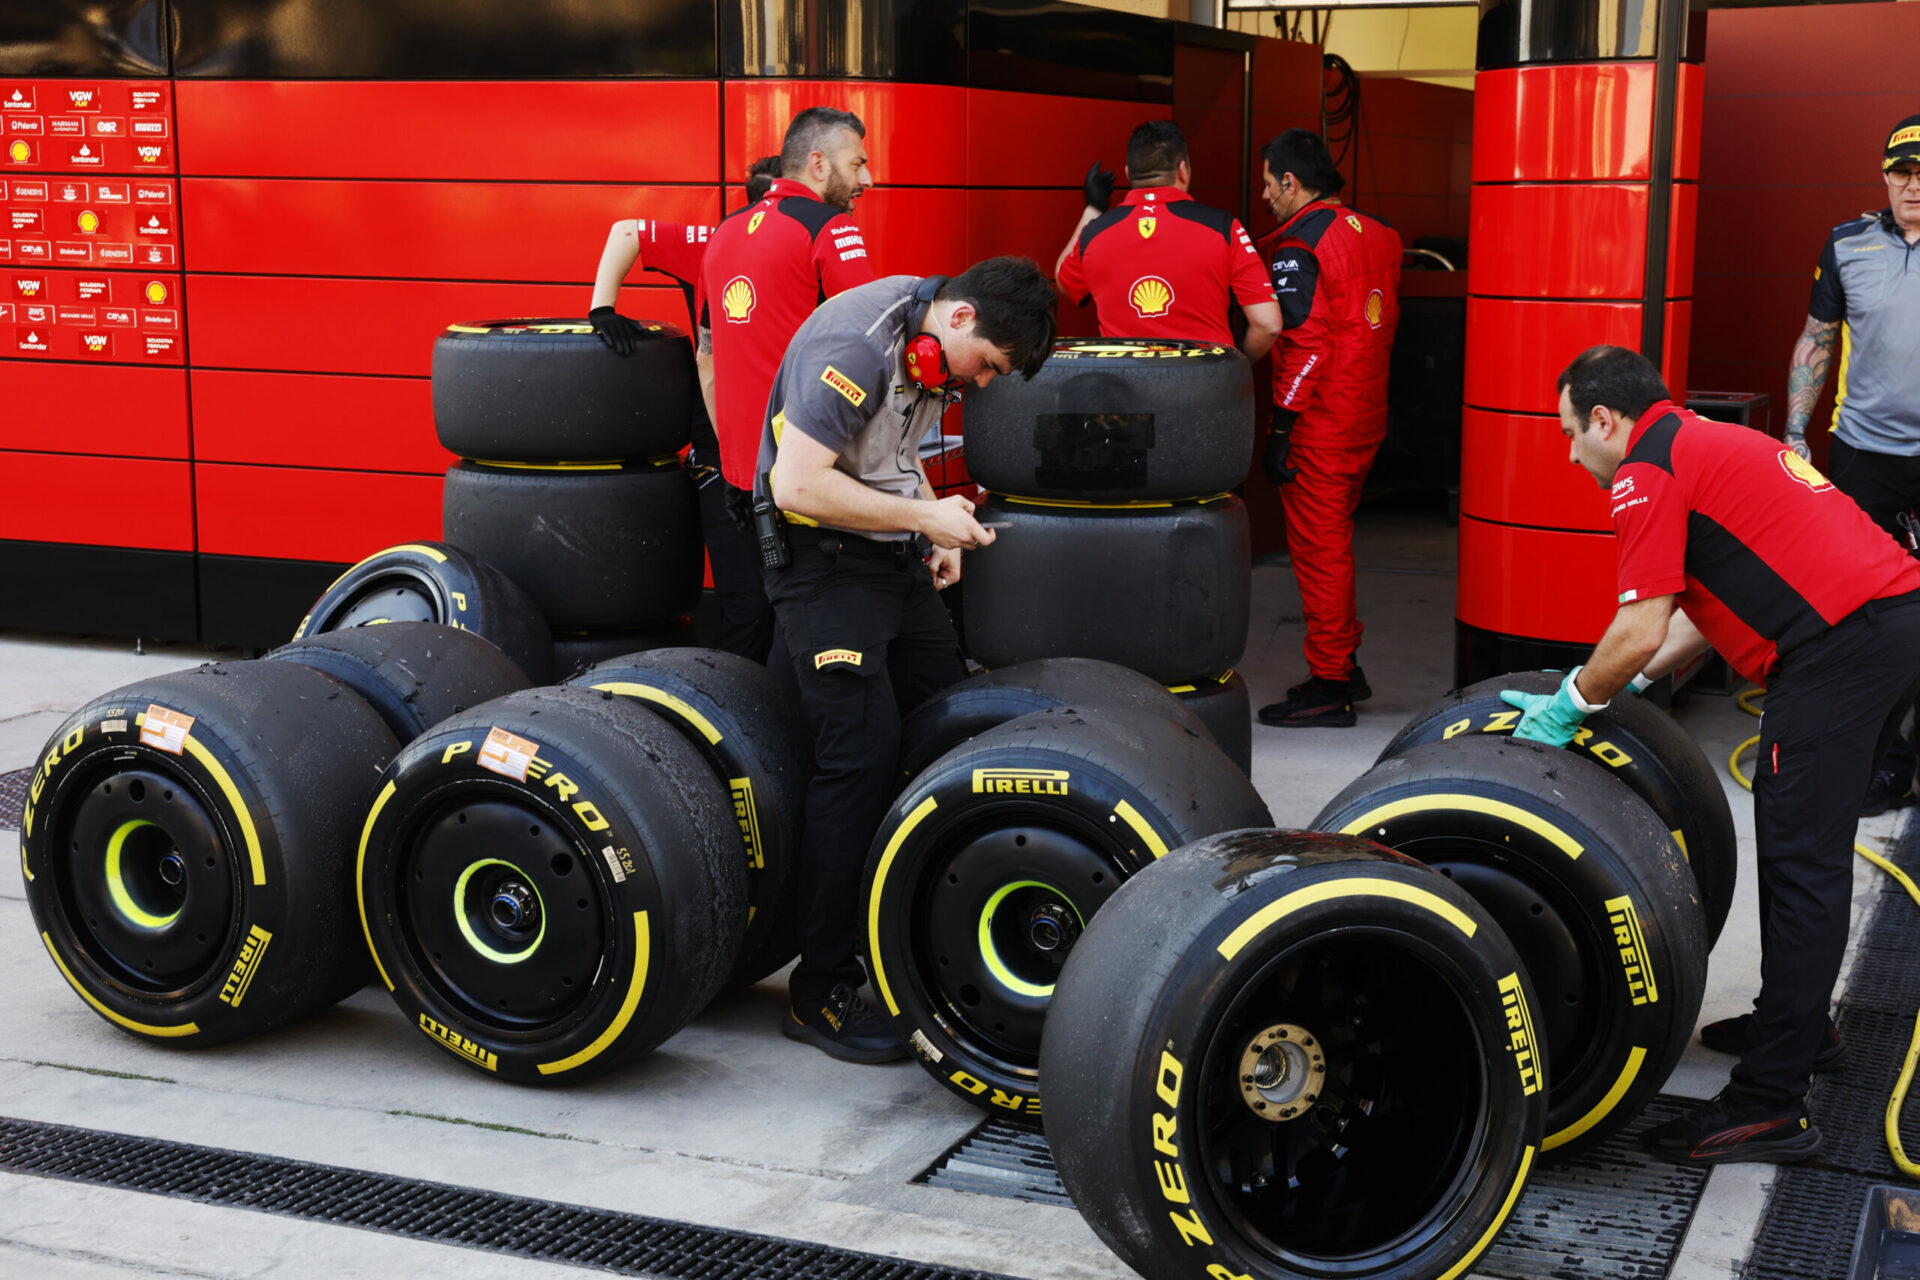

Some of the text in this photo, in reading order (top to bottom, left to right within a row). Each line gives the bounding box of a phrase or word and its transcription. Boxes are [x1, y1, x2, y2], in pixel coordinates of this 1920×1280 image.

[69, 91, 93, 101] VGW
[138, 147, 162, 157] VGW
[140, 227, 169, 235] Santander
[17, 280, 40, 290] VGW
[19, 342, 47, 350] Santander
[84, 336, 107, 345] VGW
[1300, 354, 1318, 376] MILLE
[824, 369, 863, 403] PIRELLI
[1612, 476, 1633, 494] aws
[817, 650, 859, 666] PIRELLI
[23, 724, 85, 838] ZERO
[441, 741, 610, 831] P ERO
[972, 768, 1070, 796] PIRELLI
[1604, 895, 1658, 1006] PIRELLI
[219, 924, 272, 1008] PIRELLI
[418, 1013, 498, 1072] PIRELLI
[1497, 971, 1543, 1096] PIRELLI
[949, 1070, 1042, 1115] ERO
[1152, 1050, 1214, 1247] ZERO
